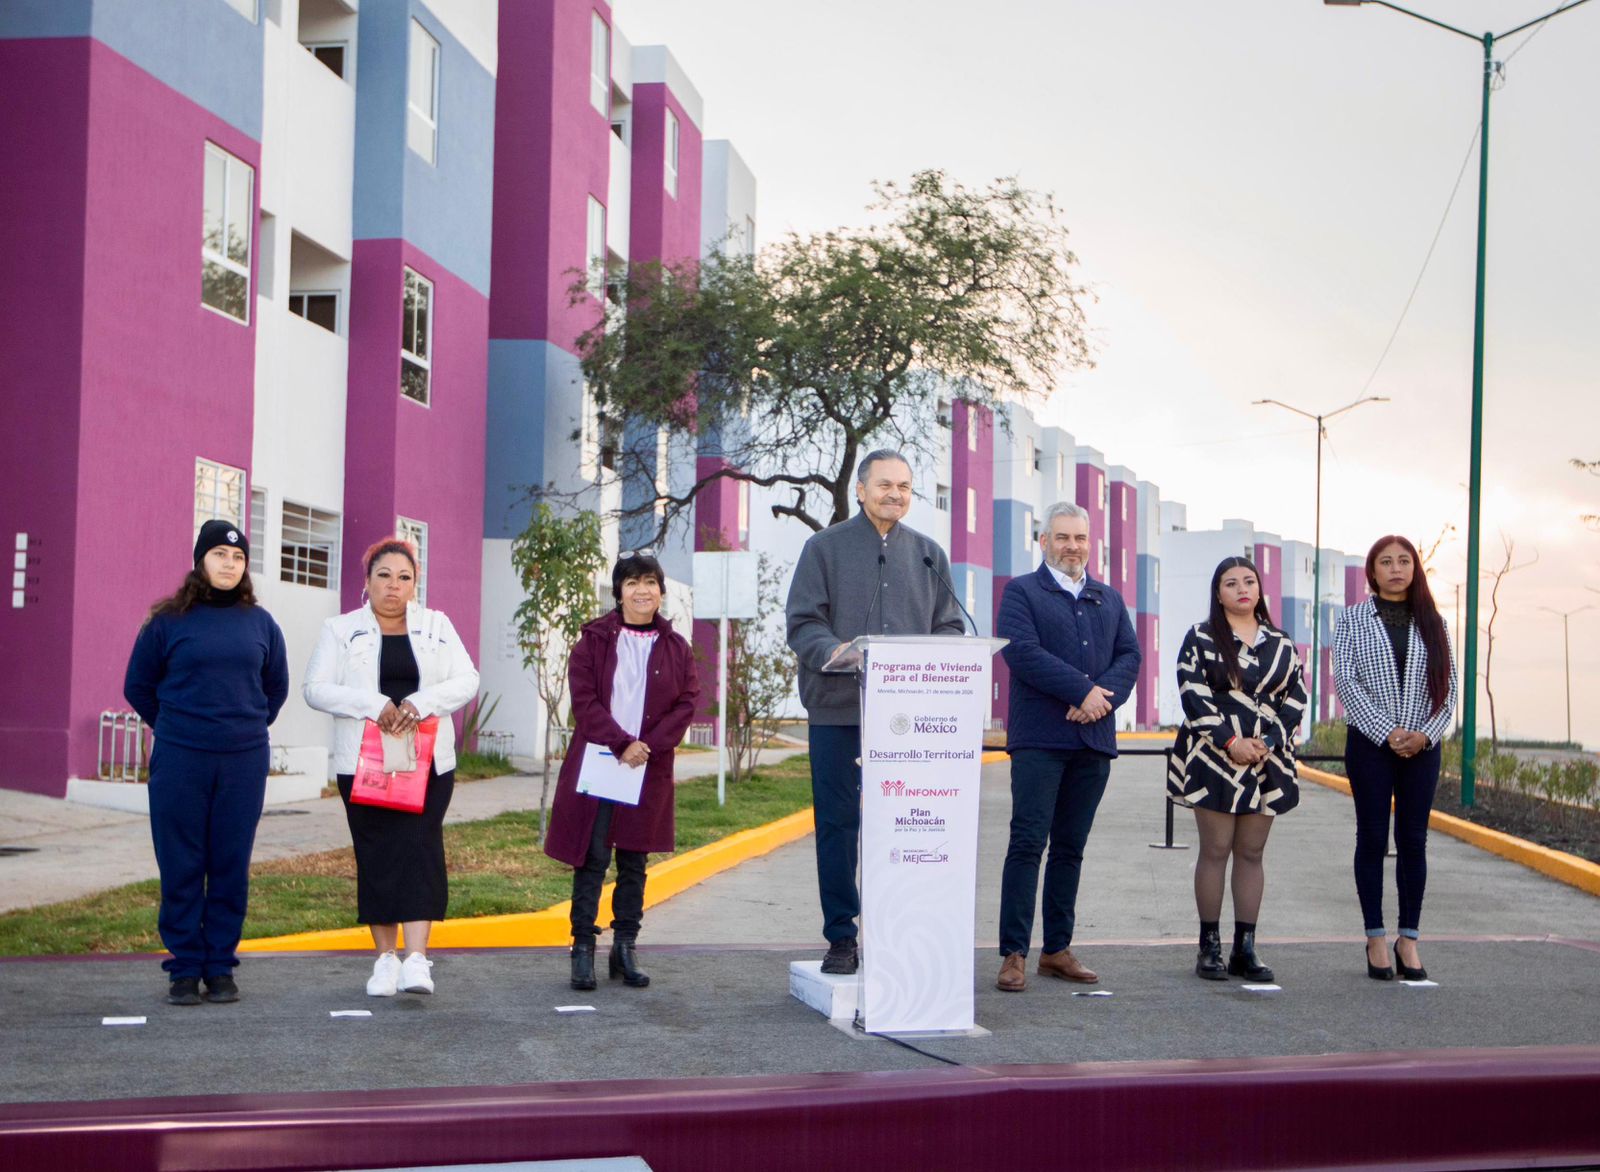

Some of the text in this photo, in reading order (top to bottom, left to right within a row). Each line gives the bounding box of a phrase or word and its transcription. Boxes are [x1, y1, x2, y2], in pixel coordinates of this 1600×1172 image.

[872, 662, 982, 673] Programa de Vivienda
[883, 674, 906, 683] para
[922, 674, 969, 682] Bienestar
[914, 722, 957, 733] México
[870, 750, 974, 759] Desarrollo Territorial
[906, 788, 960, 796] INFONAVIT
[910, 808, 930, 816] Plan
[896, 816, 945, 825] Michoacán
[903, 854, 948, 864] MEJOR
